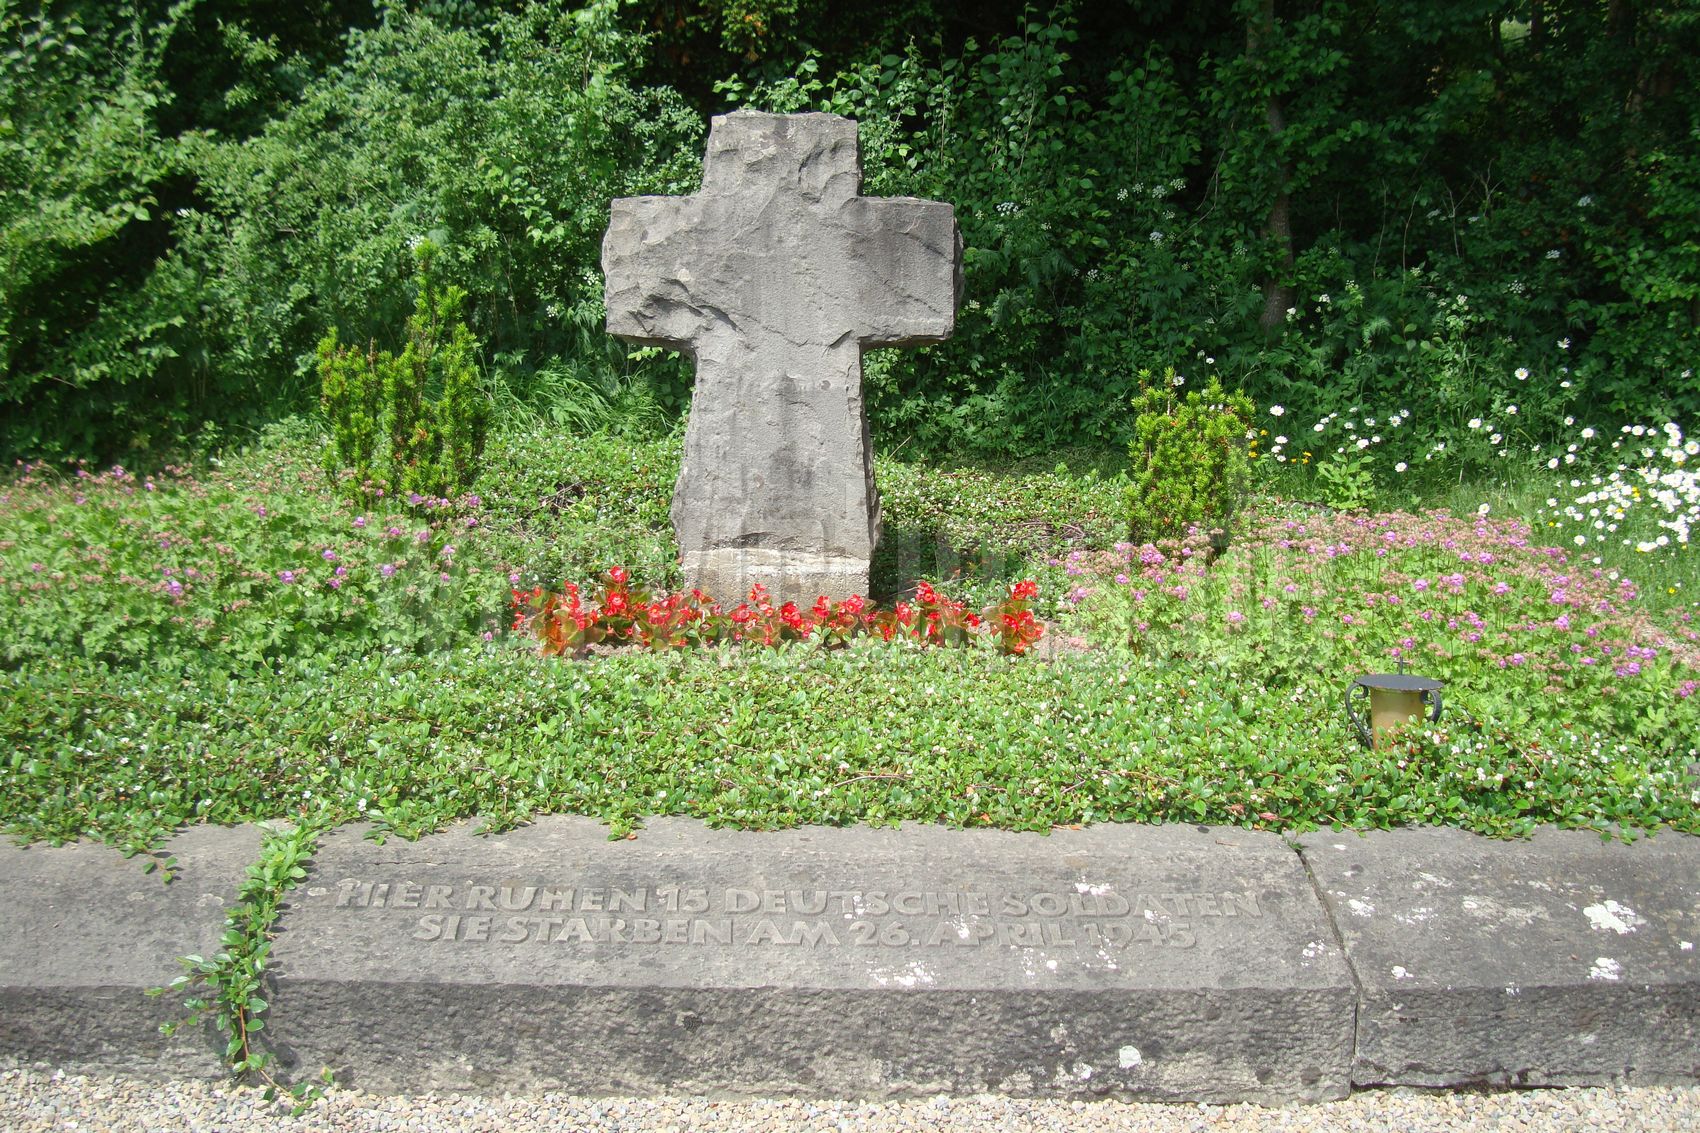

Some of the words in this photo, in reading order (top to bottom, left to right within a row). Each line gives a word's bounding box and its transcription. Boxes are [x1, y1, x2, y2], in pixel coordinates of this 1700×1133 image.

[336, 881, 455, 909] HIER
[465, 884, 646, 912] RUHEN
[665, 885, 711, 914] 15
[724, 887, 989, 917] DEUTSCHE
[1003, 890, 1264, 918] SOLDATEN
[413, 914, 491, 943] SIE
[499, 916, 733, 945] STARBEN
[745, 919, 840, 946] AM
[849, 920, 921, 947] 26.
[927, 920, 1077, 949] APRIL
[1083, 921, 1198, 949] 1945
